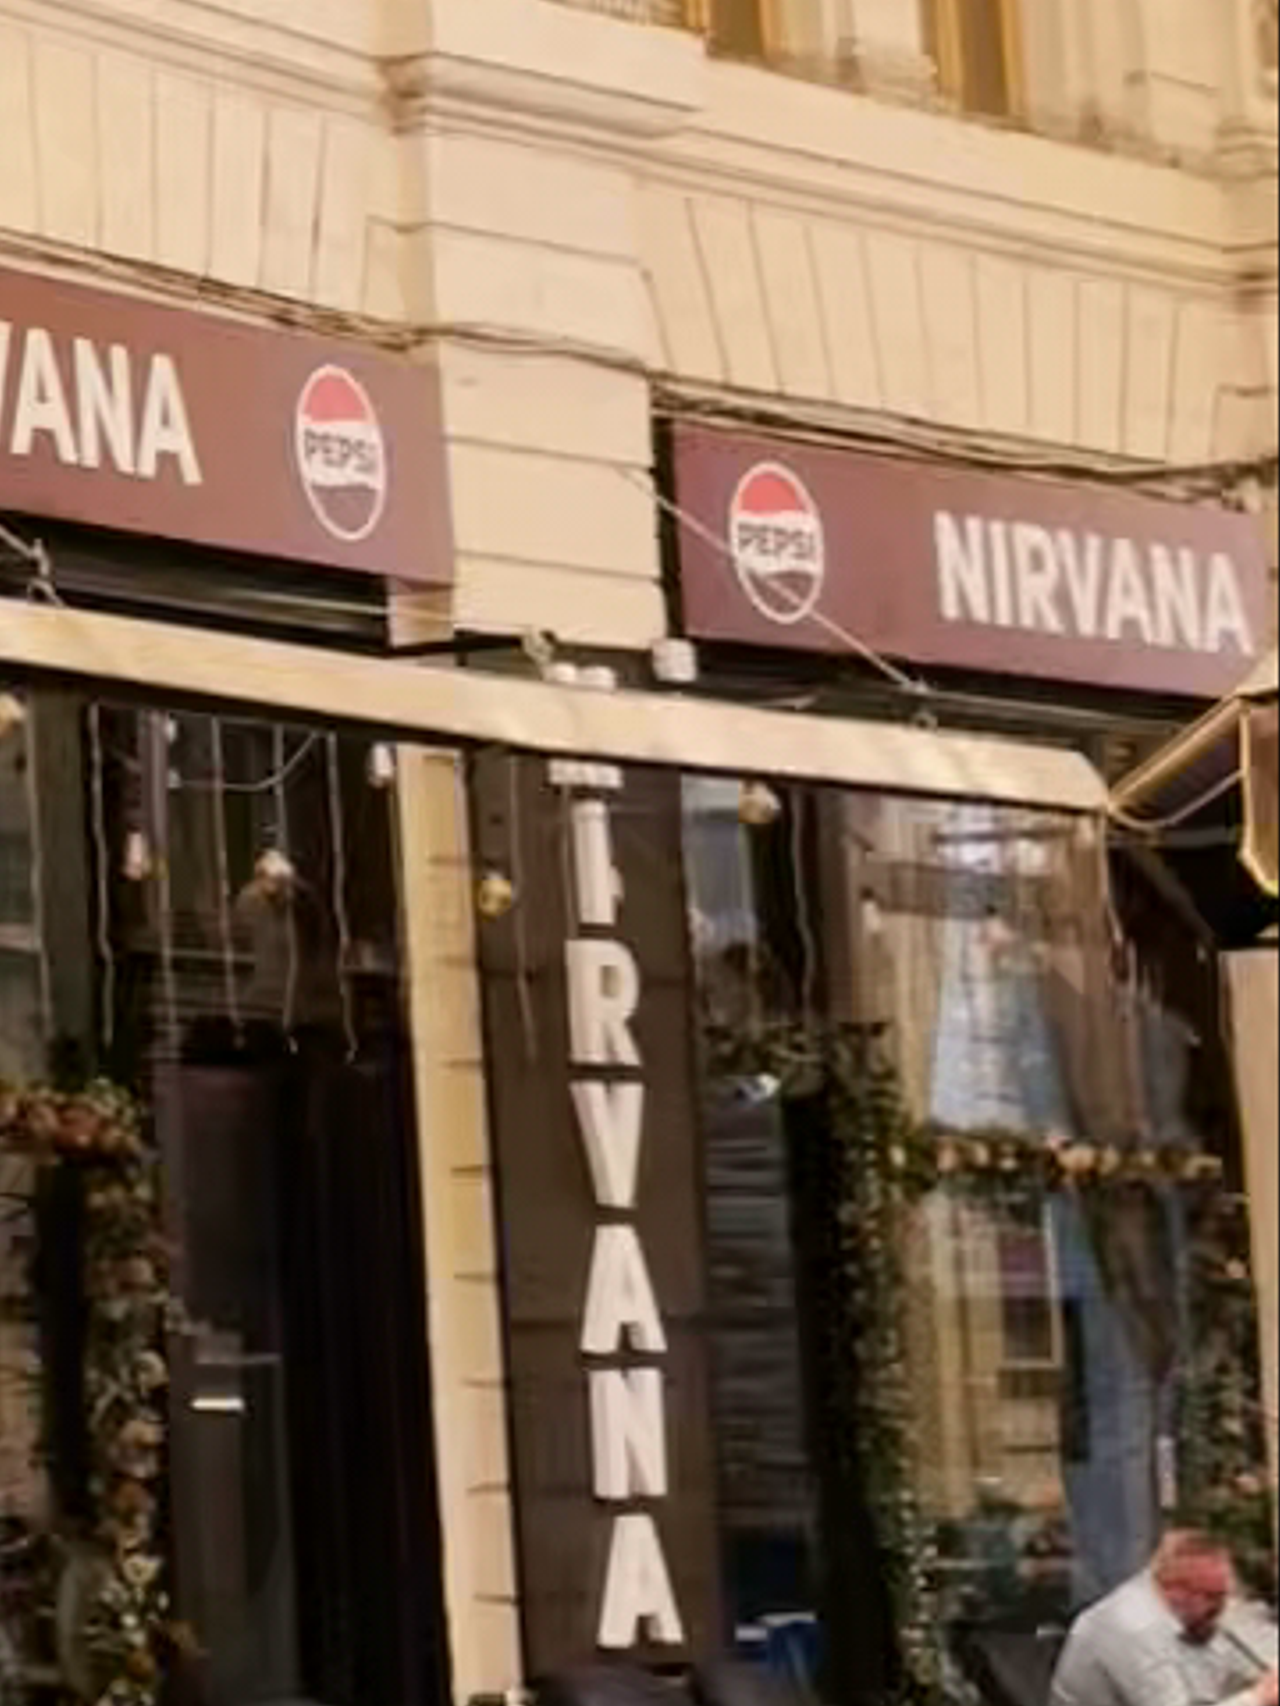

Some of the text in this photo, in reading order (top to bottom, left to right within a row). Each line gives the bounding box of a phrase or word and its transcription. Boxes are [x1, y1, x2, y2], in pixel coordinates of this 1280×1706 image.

[303, 427, 377, 474] PEPSI
[737, 521, 817, 564] PEPSI
[934, 511, 1254, 655] NIRVANA
[546, 758, 684, 1649] IRVANA
